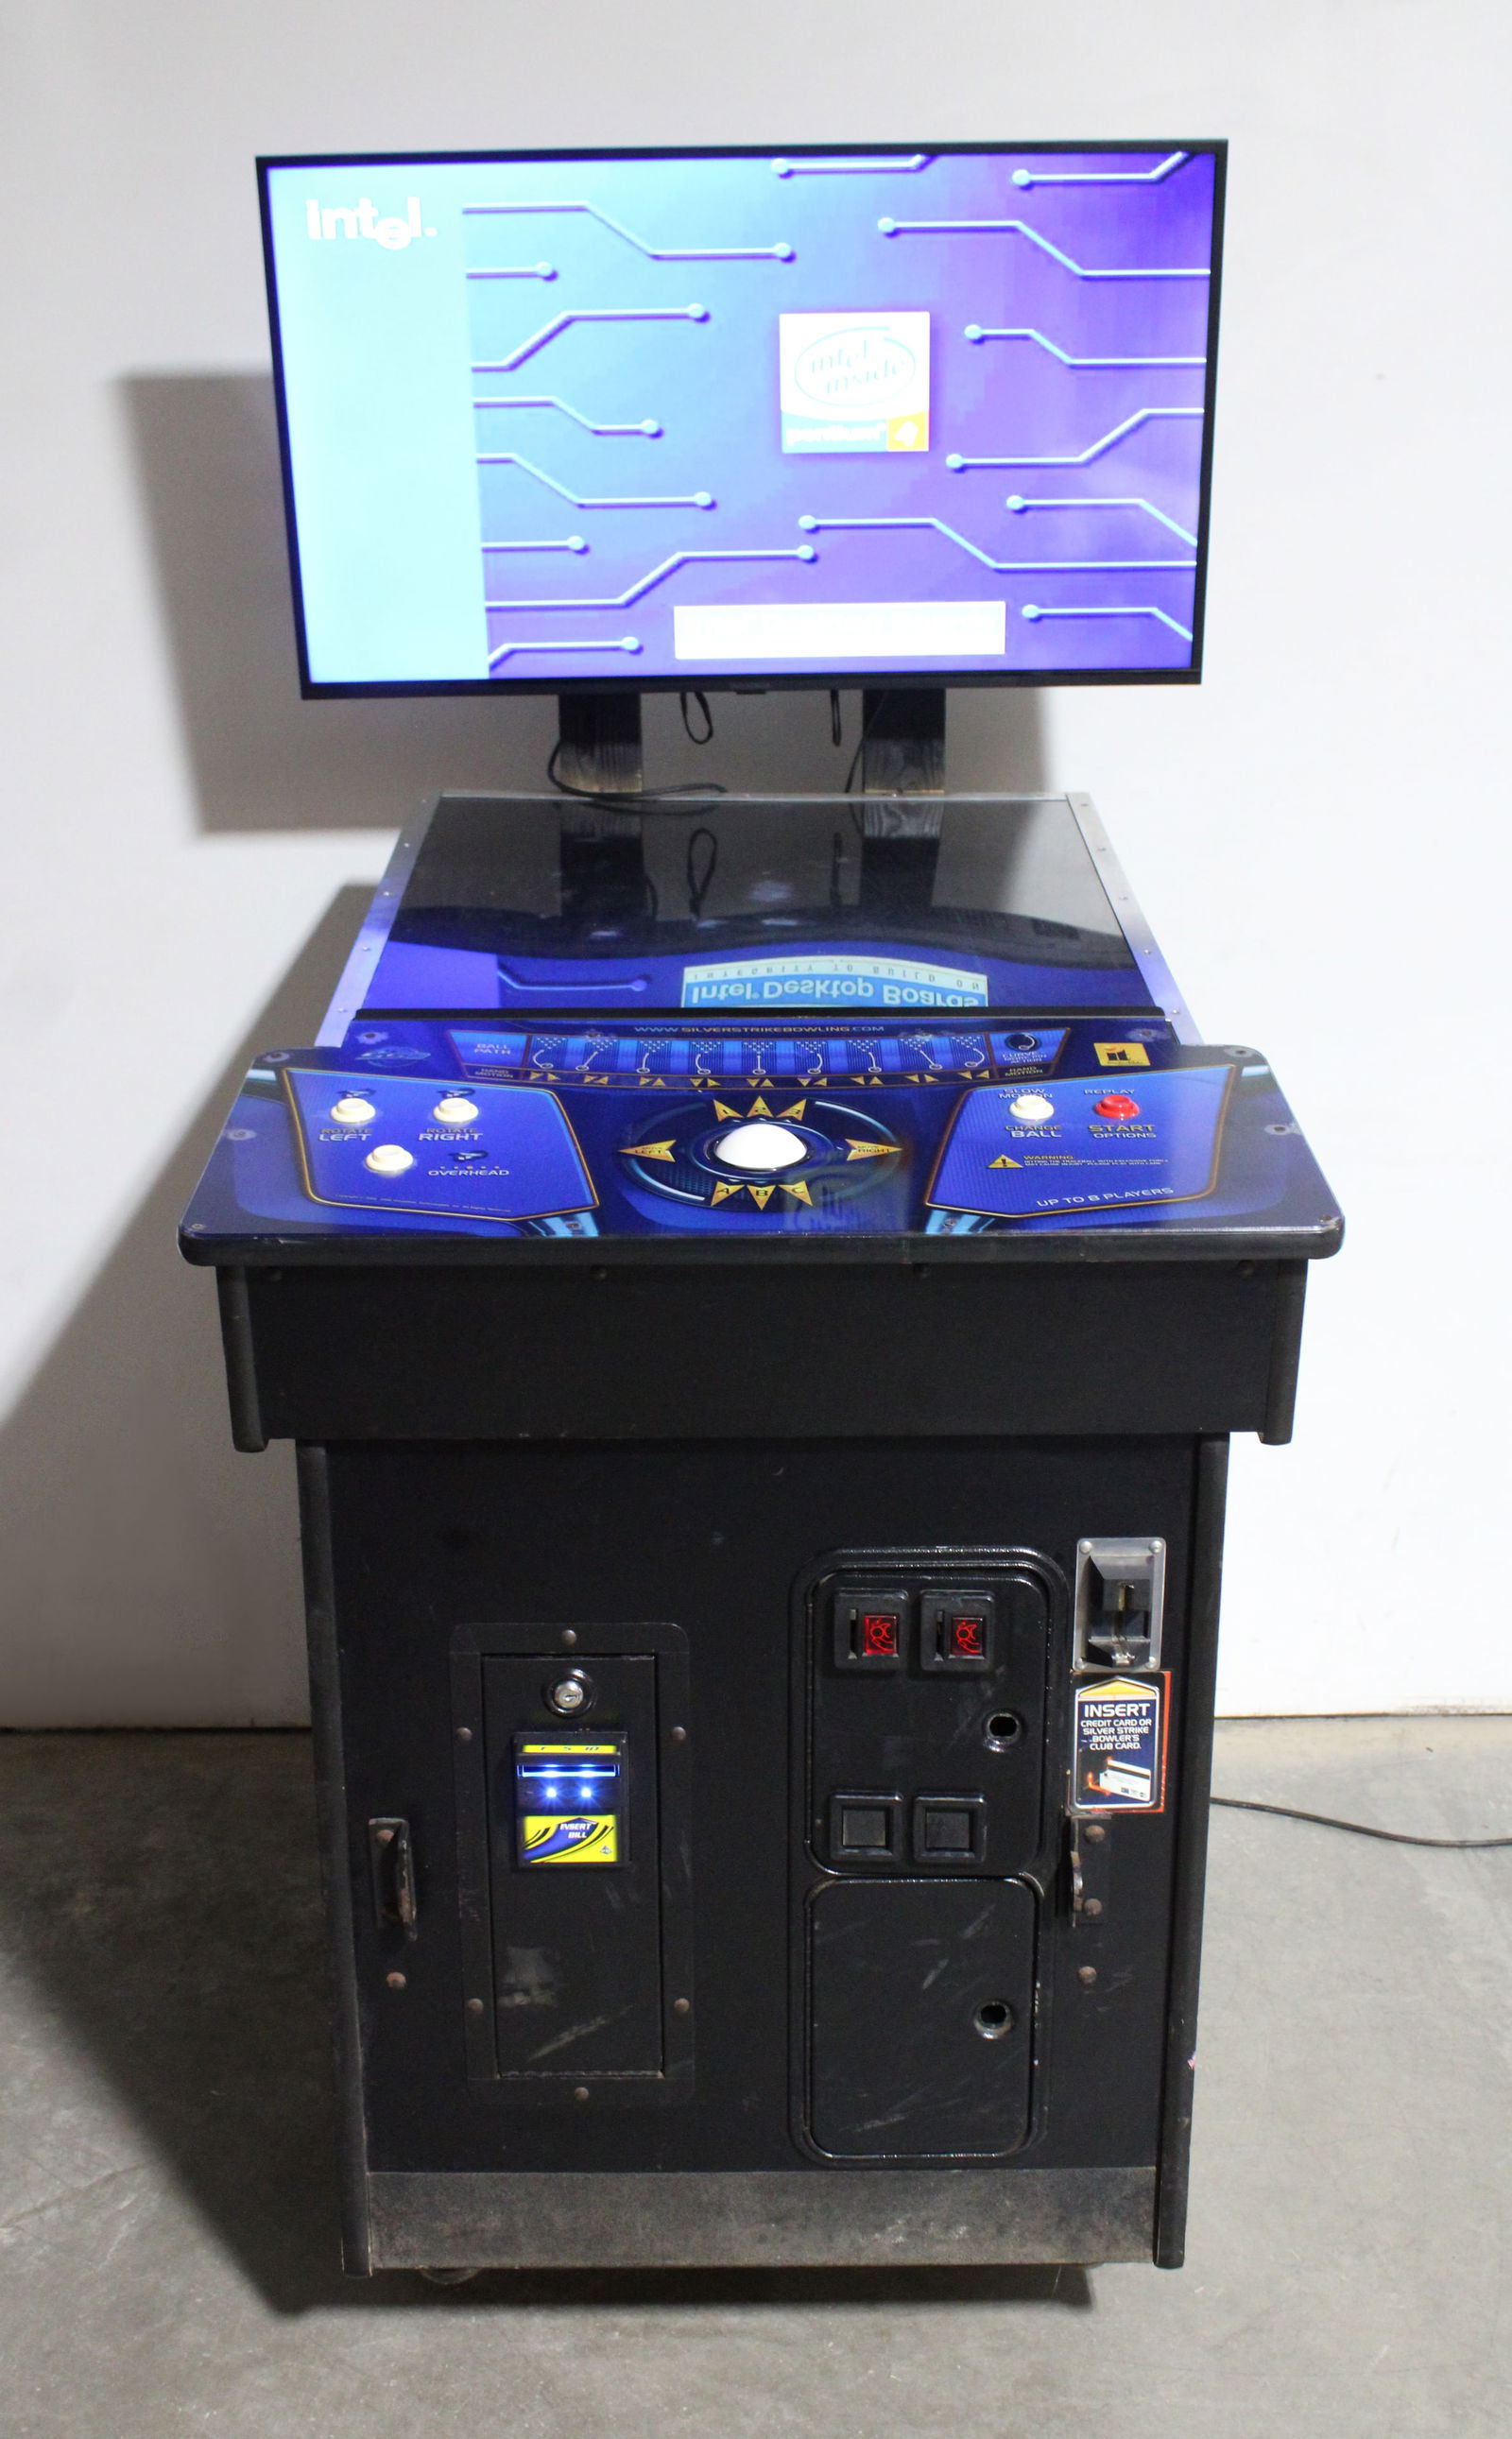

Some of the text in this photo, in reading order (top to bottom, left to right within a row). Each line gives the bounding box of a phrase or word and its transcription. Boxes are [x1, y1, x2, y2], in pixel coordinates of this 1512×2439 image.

[318, 1133, 372, 1142] LEFT
[418, 1133, 484, 1142] RIGHT
[755, 1189, 768, 1197] B
[1037, 1198, 1060, 1207] UP
[1061, 1195, 1086, 1205] TO
[1103, 1187, 1175, 1201] PLAYERS
[1083, 1703, 1151, 1718] INSERT
[1080, 1718, 1153, 1728] CREDIT CARD OR
[1082, 1727, 1115, 1736] SILVER
[1091, 1734, 1141, 1743] BOWLER'S
[1090, 1742, 1143, 1751] CLUB CARD.
